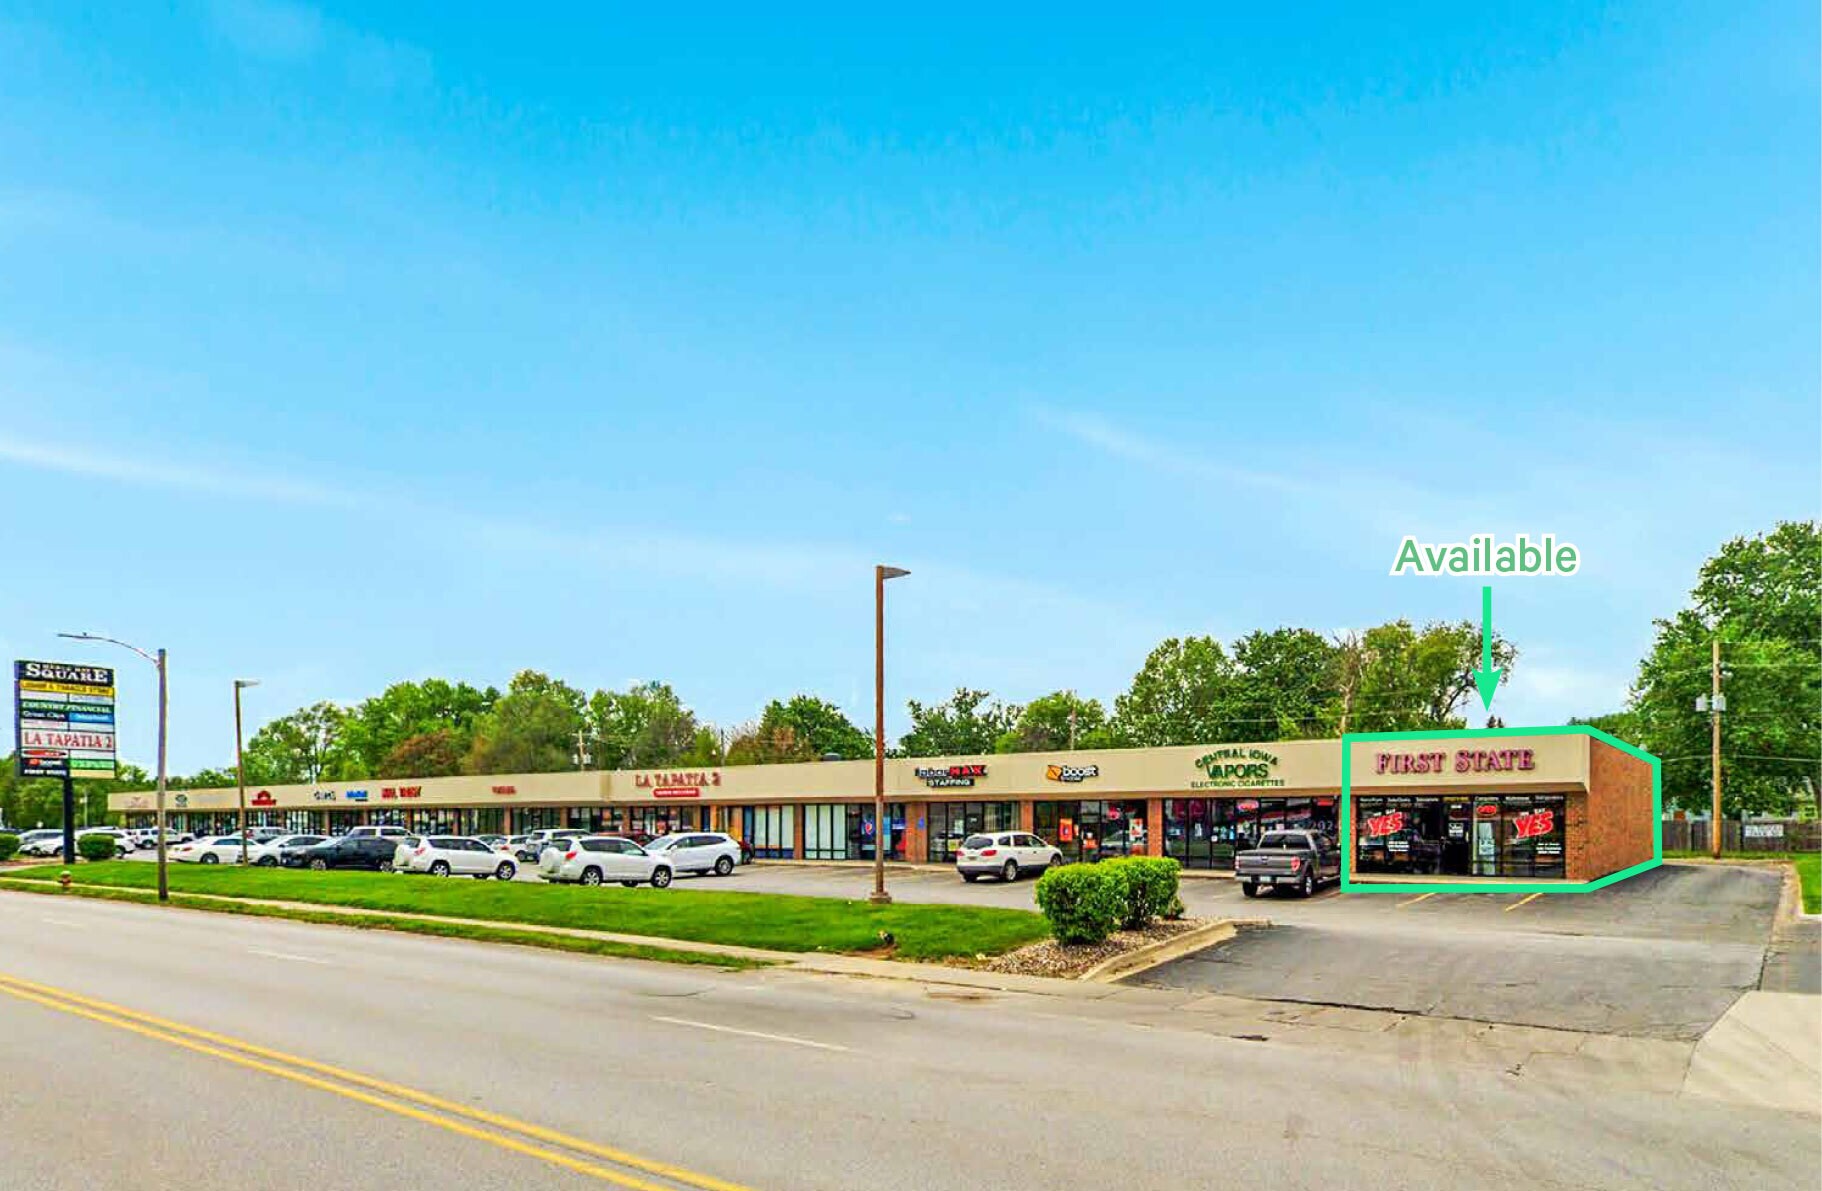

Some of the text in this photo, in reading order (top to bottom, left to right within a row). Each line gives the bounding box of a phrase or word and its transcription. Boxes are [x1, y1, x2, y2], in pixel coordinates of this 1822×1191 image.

[26, 663, 108, 683] SQUARE
[24, 732, 112, 748] LA TAPATIA 2
[1195, 748, 1278, 769] CENTRAL IOWA
[1376, 748, 1535, 775] FIRST STATE
[1062, 765, 1097, 777] boost
[1205, 763, 1269, 778] VAPORS
[635, 772, 721, 787] LA TAPATIA 2
[927, 779, 971, 787] STAFFING
[1190, 779, 1285, 788] ELECTRONIC CIGARETTES
[1366, 811, 1403, 838] YES
[1512, 810, 1554, 839] YES
